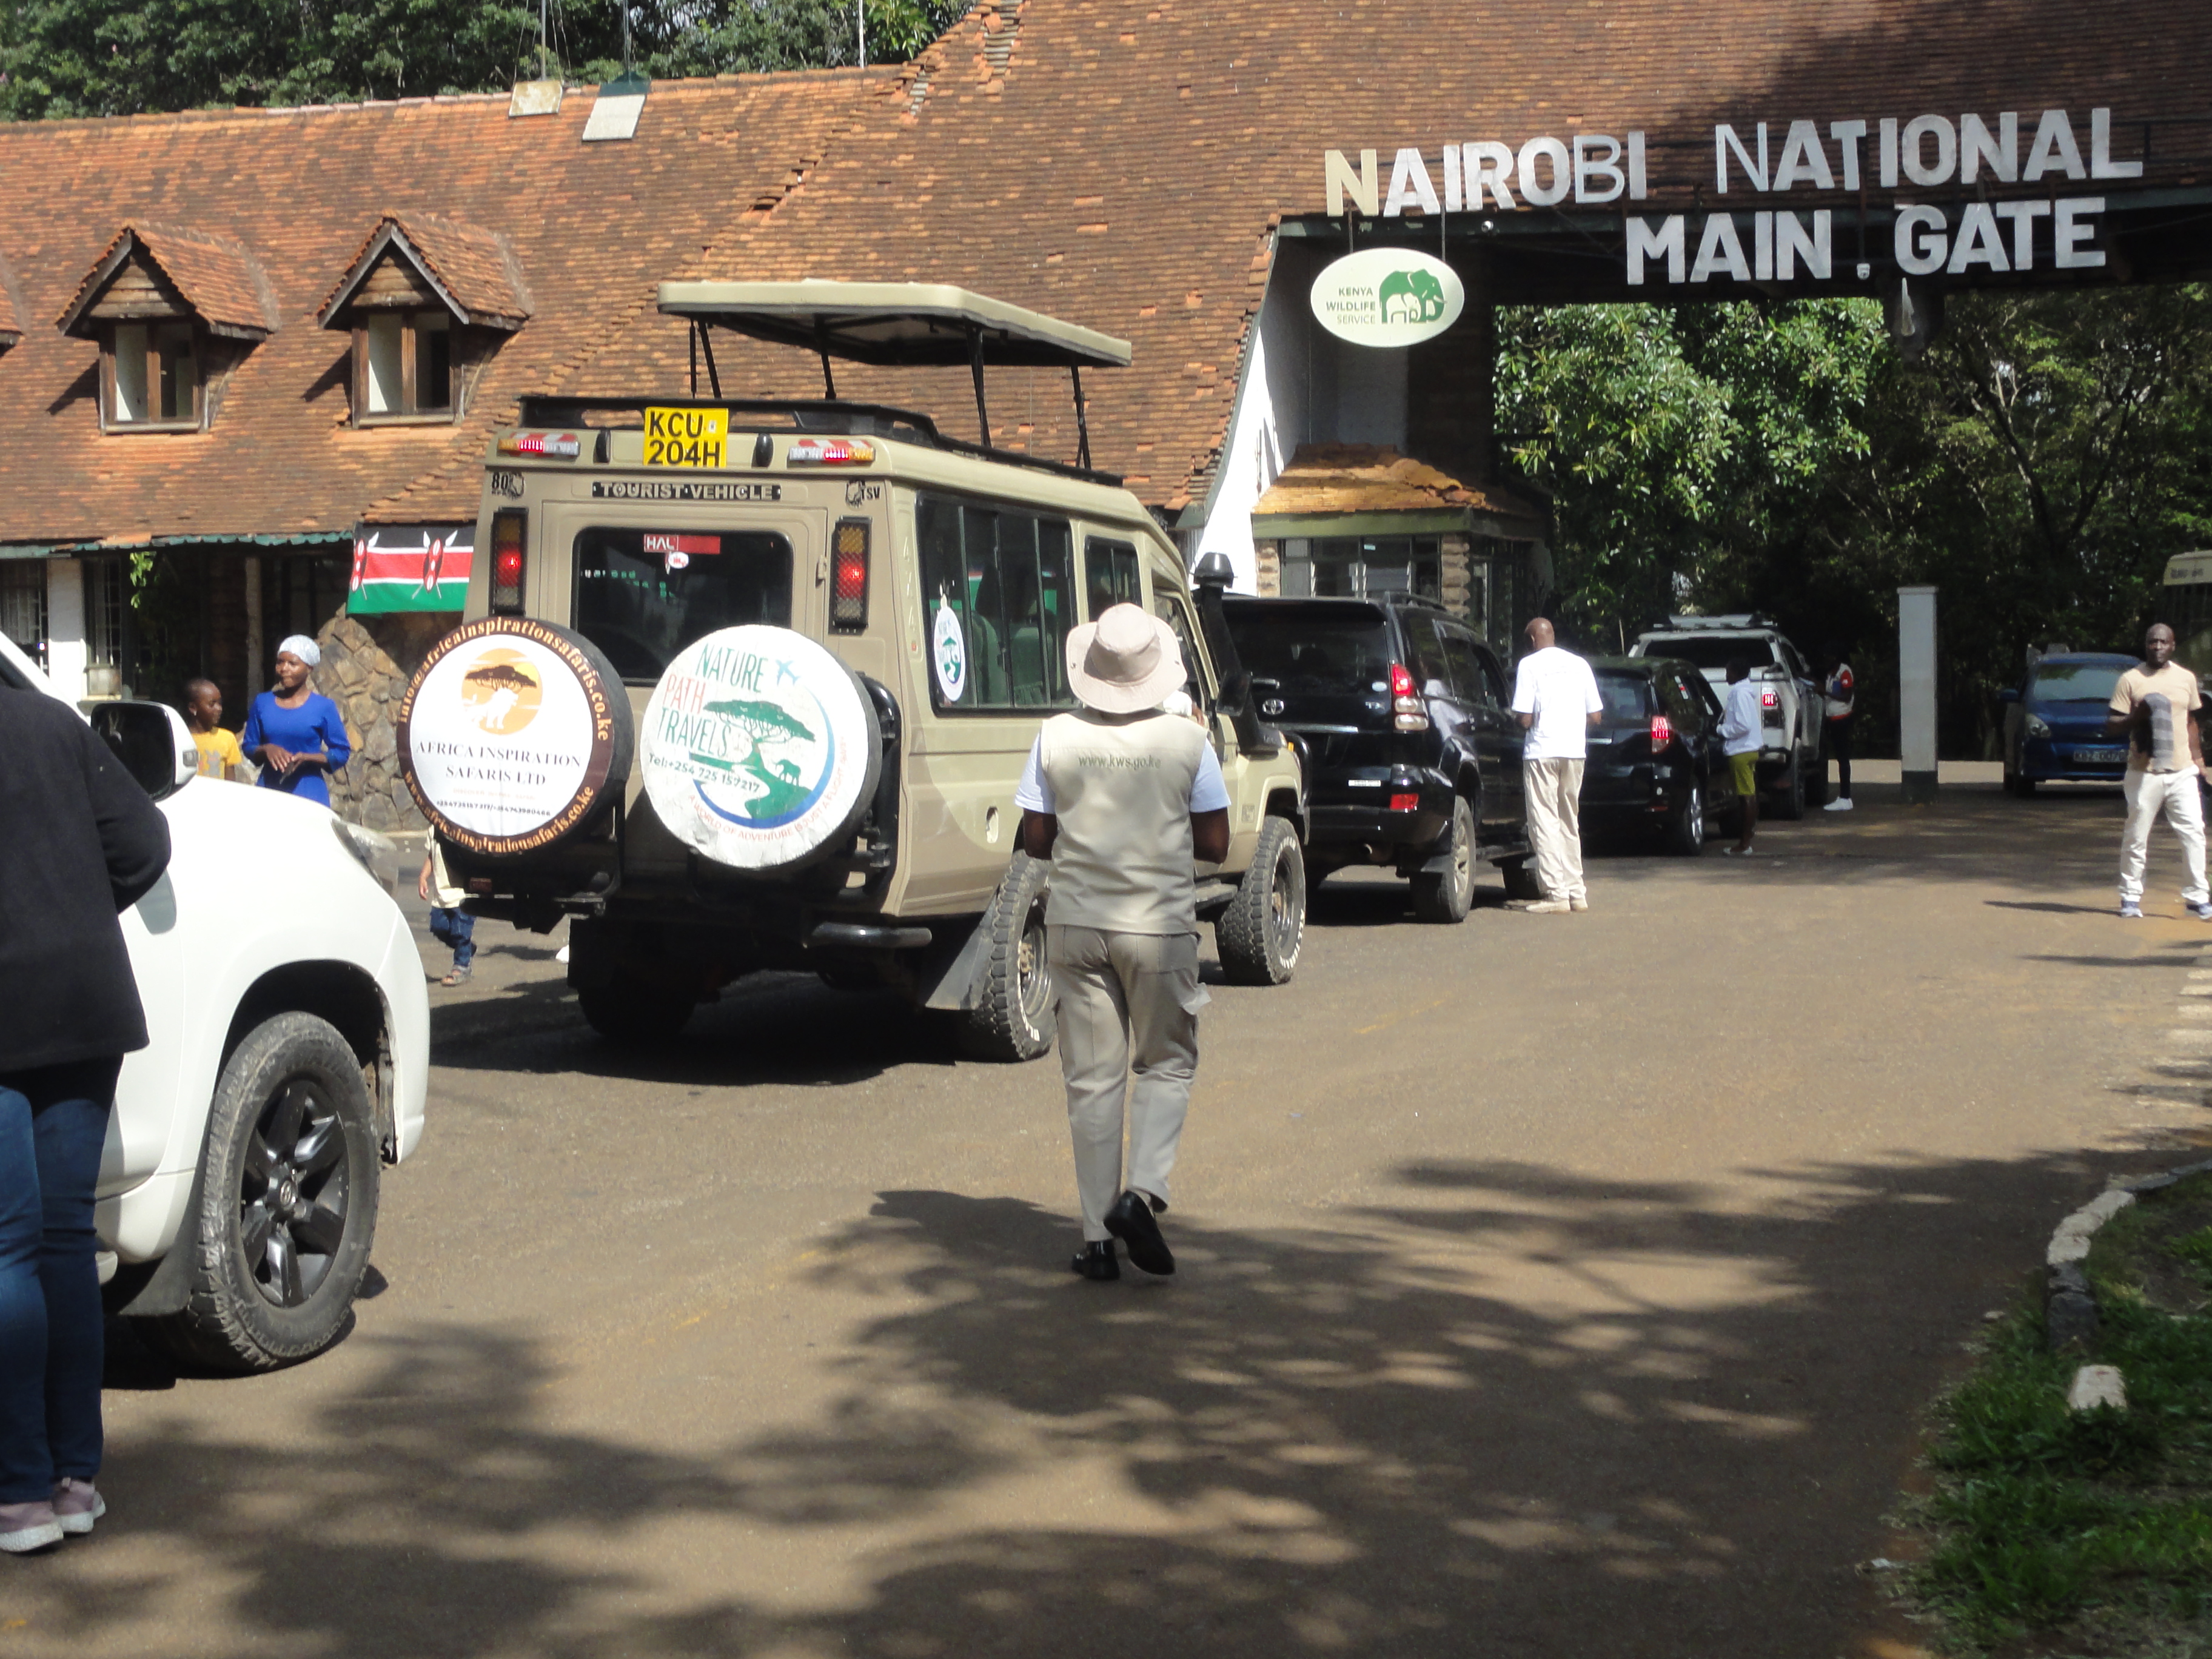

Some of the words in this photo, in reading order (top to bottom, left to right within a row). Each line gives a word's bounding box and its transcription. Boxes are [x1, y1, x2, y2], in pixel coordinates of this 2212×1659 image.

[1324, 130, 1647, 218] NAIROBI
[1715, 107, 2143, 194] NATIONAL
[1625, 209, 1832, 286] MAIN
[1894, 197, 2106, 275] GATE
[1338, 287, 1373, 297] KENYA
[1326, 301, 1376, 311] WILDLIFE
[1336, 314, 1376, 324] SERVICE
[649, 411, 703, 438] KCU
[648, 440, 720, 467] 204H
[601, 482, 685, 499] TOURIST
[690, 484, 773, 500] VEHICLE
[695, 643, 768, 693] NATURE
[662, 674, 706, 715] PATH
[657, 707, 732, 758] TRAVELS
[416, 740, 474, 758] AFRICA
[480, 746, 581, 768] INSPIRATION
[1079, 754, 1161, 771] www.kws.go.ke
[446, 765, 511, 782] SAFARIS
[517, 771, 546, 786] LTD
[699, 767, 717, 782] 725
[694, 802, 722, 830] WORLD
[723, 826, 737, 835] OF
[738, 828, 795, 842] ADVENTURE
